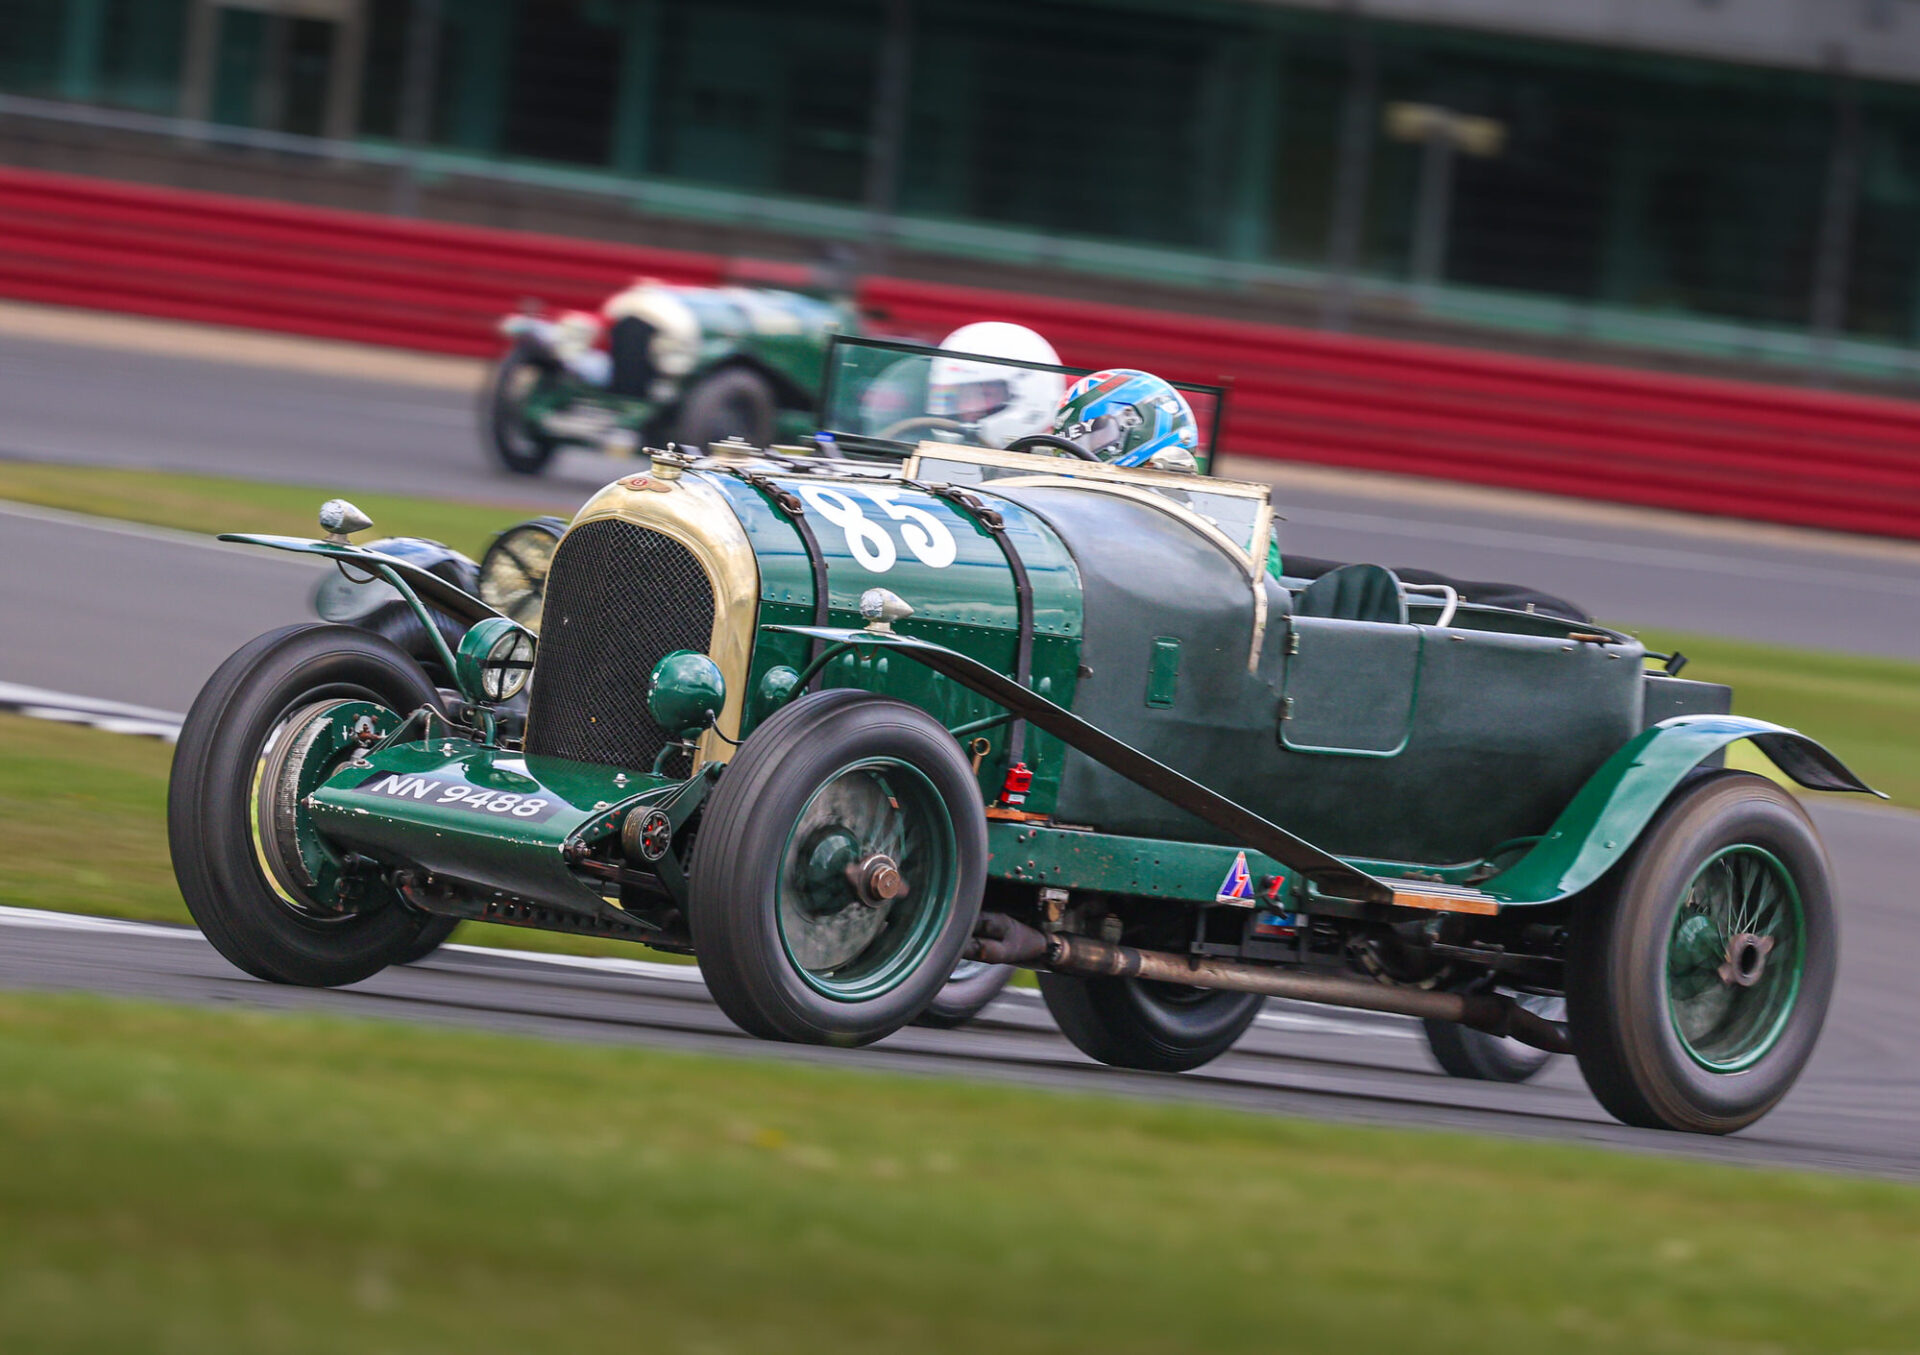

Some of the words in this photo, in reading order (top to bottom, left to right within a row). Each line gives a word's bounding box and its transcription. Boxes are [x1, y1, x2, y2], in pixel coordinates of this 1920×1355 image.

[798, 485, 957, 573] 85
[371, 775, 441, 799] NN
[436, 786, 548, 817] 9488
